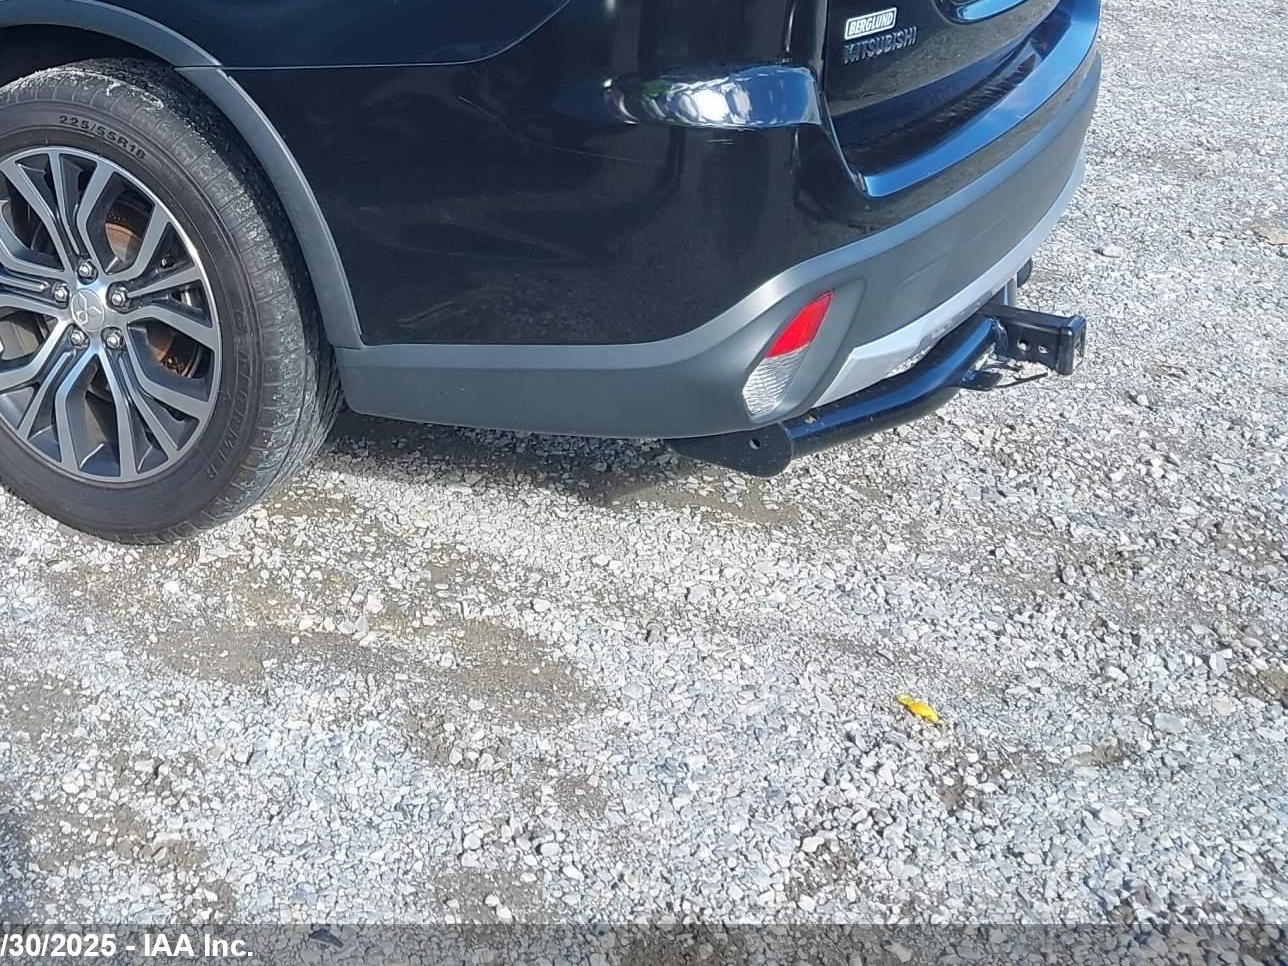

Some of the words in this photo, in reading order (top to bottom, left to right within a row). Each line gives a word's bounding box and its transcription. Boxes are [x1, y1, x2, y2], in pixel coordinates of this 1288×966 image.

[849, 12, 894, 35] BERGLUND
[844, 27, 917, 64] MITSUBISHI
[59, 114, 146, 159] 225/55R18
